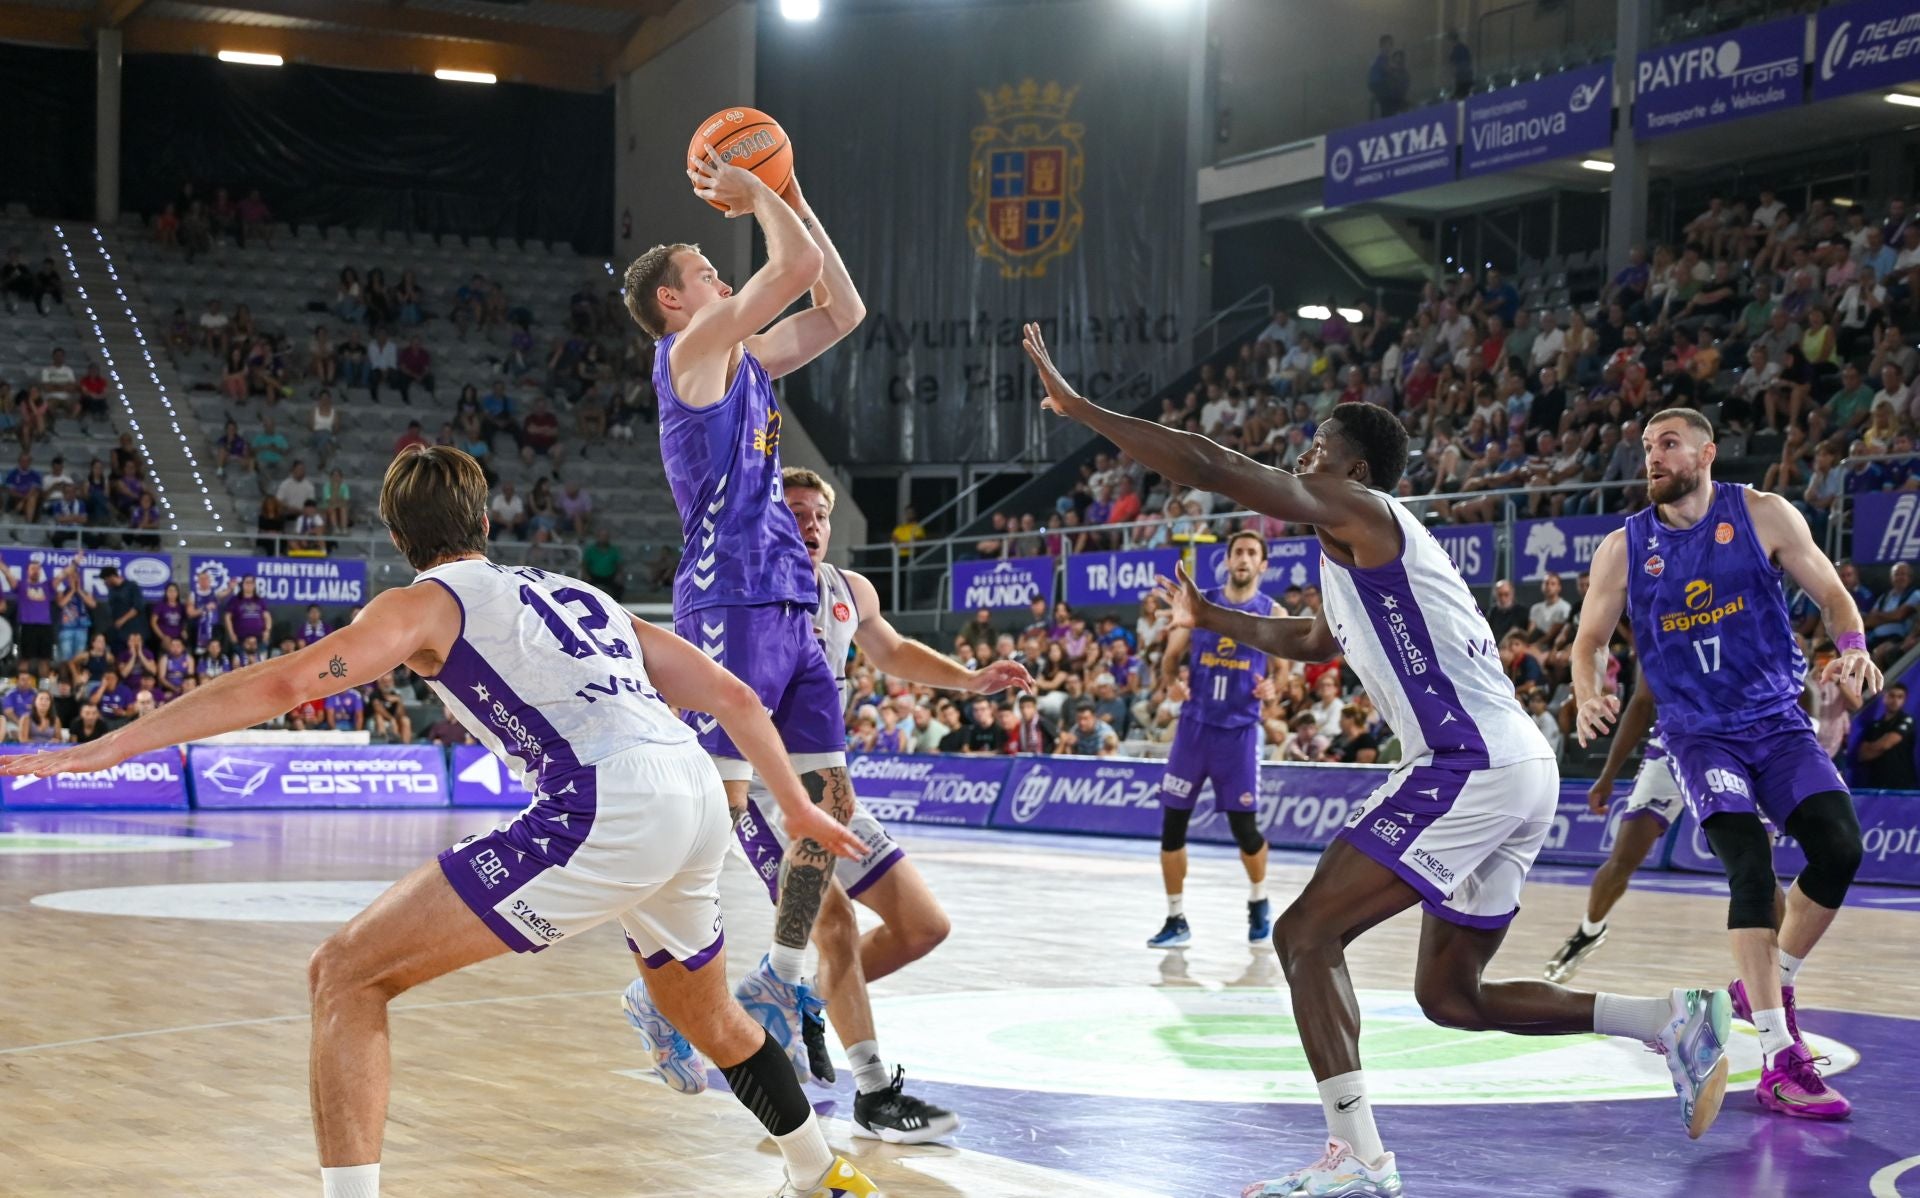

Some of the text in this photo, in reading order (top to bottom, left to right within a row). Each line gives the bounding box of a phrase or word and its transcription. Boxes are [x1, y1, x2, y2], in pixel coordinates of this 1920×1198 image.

[1648, 104, 1706, 128] Transporte
[1710, 96, 1727, 116] de
[1358, 121, 1448, 164] VAYMA
[1471, 111, 1567, 153] Villanova
[707, 128, 777, 171] Wilso
[964, 363, 1152, 405] Palcia
[47, 553, 121, 567] Horalizas
[257, 562, 339, 578] FERRETERÍA
[293, 580, 361, 602] LLAMAS
[965, 582, 1040, 608] MUNDO
[519, 583, 633, 659] 12
[1661, 595, 1745, 632] agropal
[1692, 635, 1721, 674] 17
[1213, 674, 1228, 701] 11
[289, 758, 422, 772] contenedores
[280, 774, 438, 794] CASTRO
[921, 781, 1001, 804] MODOS
[1373, 817, 1406, 842] CBC
[475, 848, 510, 885] CBC
